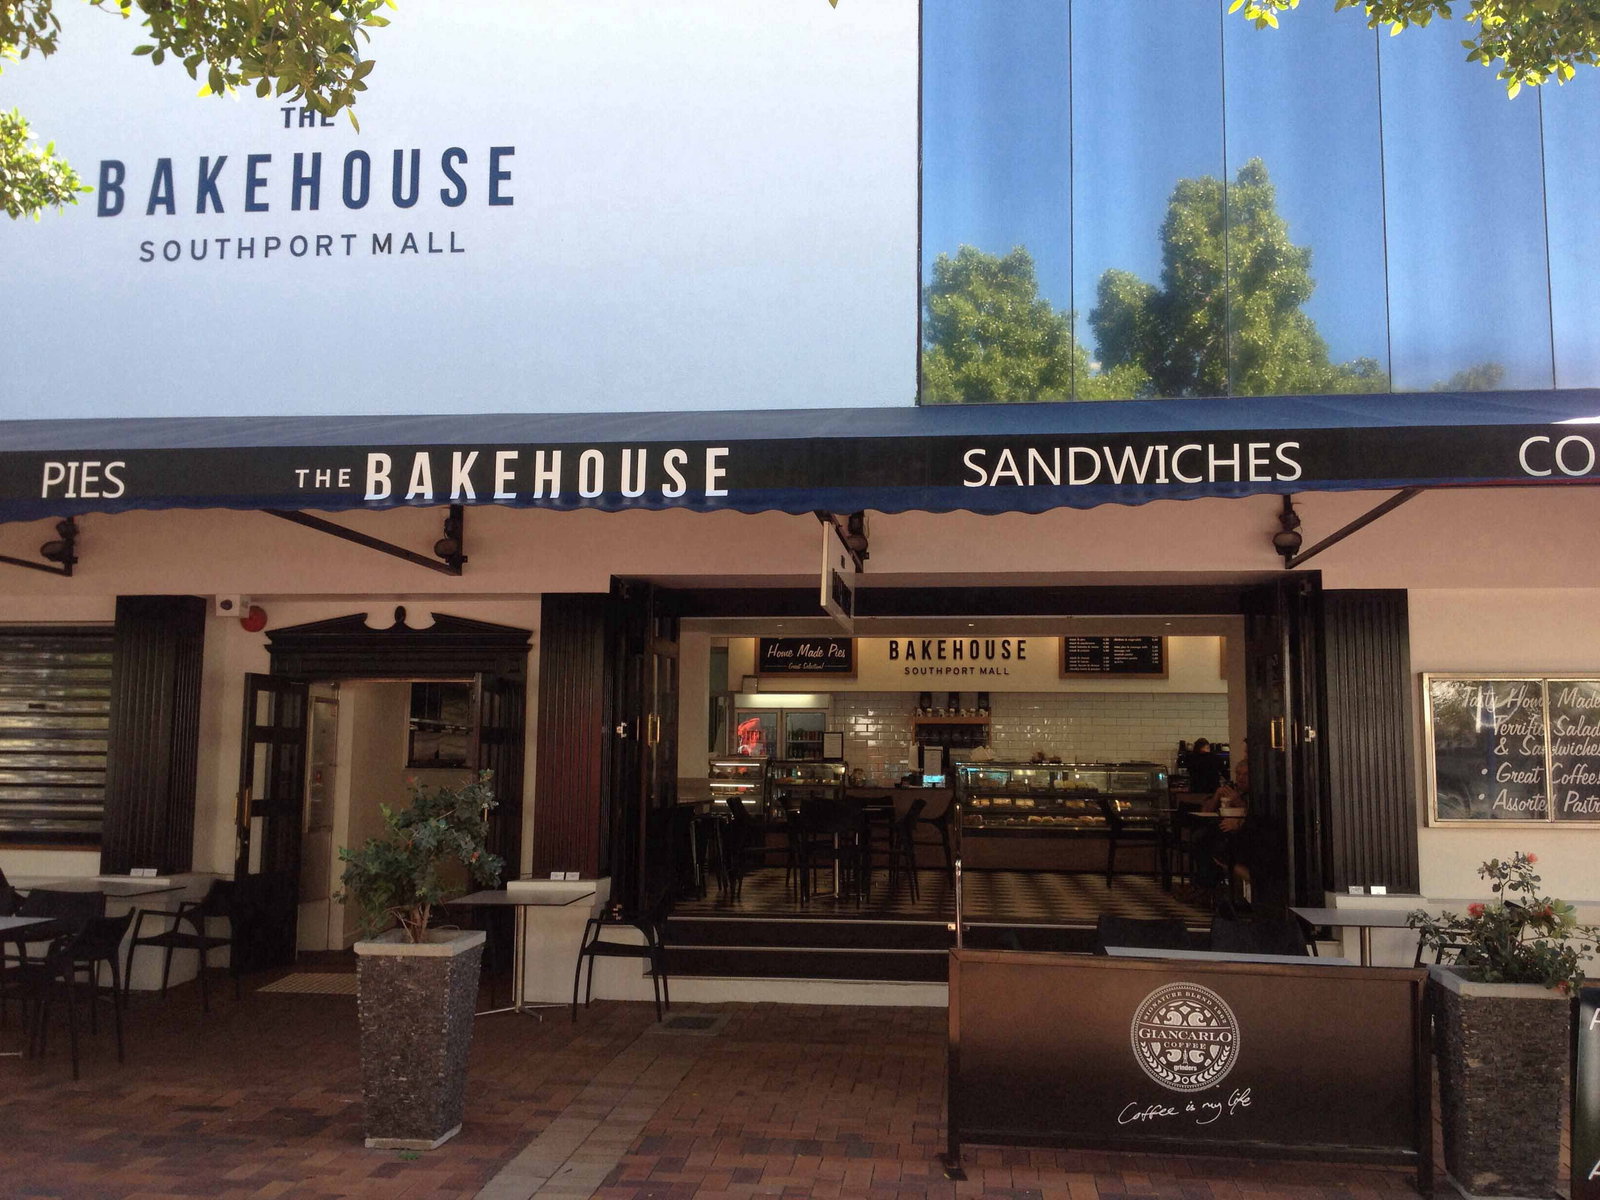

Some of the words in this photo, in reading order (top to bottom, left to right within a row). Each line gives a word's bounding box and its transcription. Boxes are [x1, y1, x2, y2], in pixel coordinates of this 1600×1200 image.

[97, 145, 515, 217] BAKEHOUSE
[139, 233, 358, 263] SOUTHPORT
[371, 231, 465, 255] MALL
[962, 442, 1302, 488] SANDWICHES
[1519, 435, 1596, 477] CO
[41, 460, 127, 499] PIES
[295, 468, 352, 489] THE
[364, 446, 730, 501] BAKEHOUSE
[767, 643, 794, 658] Home
[797, 643, 824, 658] Made
[828, 643, 846, 658] Pies
[889, 639, 1027, 660] BAKEHOUSE
[904, 666, 975, 676] SOUTHPORT
[979, 666, 1010, 676] MALL
[1494, 737, 1509, 756] &
[1496, 761, 1544, 784] Great
[1138, 1027, 1232, 1043] GIANCARLO
[1163, 1042, 1207, 1050] COFFEE
[1117, 1102, 1179, 1125] Coffee
[1185, 1101, 1196, 1112] is
